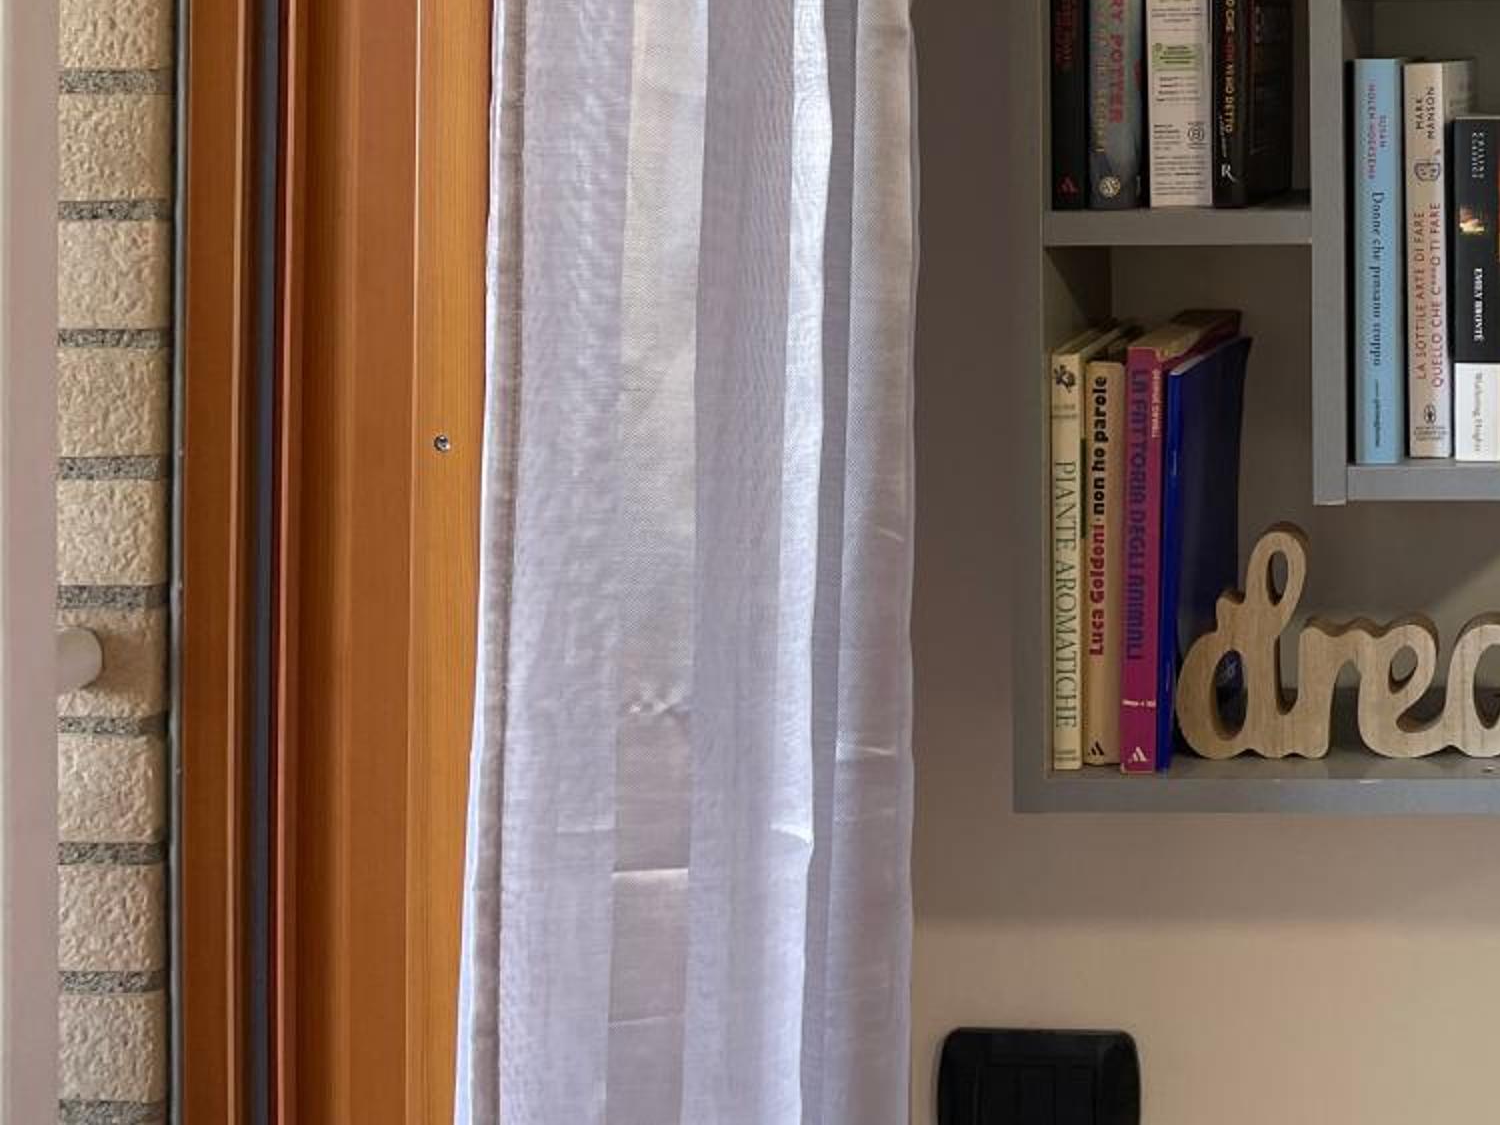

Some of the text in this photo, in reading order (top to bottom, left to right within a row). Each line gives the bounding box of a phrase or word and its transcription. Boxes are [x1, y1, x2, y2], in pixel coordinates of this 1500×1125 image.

[1108, 32, 1125, 123] POTTER
[1224, 95, 1235, 134] DETTO
[1379, 114, 1388, 147] SUSAN
[1415, 98, 1424, 130] MARK
[1426, 86, 1436, 140] MANSON
[1371, 191, 1385, 236] Donne
[1429, 203, 1440, 234] FARE
[1371, 238, 1385, 262] che
[1430, 240, 1440, 251] TI
[1369, 265, 1382, 317] pensano
[1413, 211, 1427, 380] LA SOTTILE ARTE DI FARE
[1474, 267, 1484, 298] EMILY
[1431, 302, 1442, 328] CHE
[1370, 322, 1382, 367] troppo
[1431, 333, 1445, 387] QUELLO
[1054, 460, 1077, 552] PIANTE
[1088, 376, 1109, 656] Luca Goldoni non ho parole
[1126, 369, 1148, 661] LA FATTORIA DEGLI ANIMALI
[1055, 559, 1077, 728] AROMATICHE
